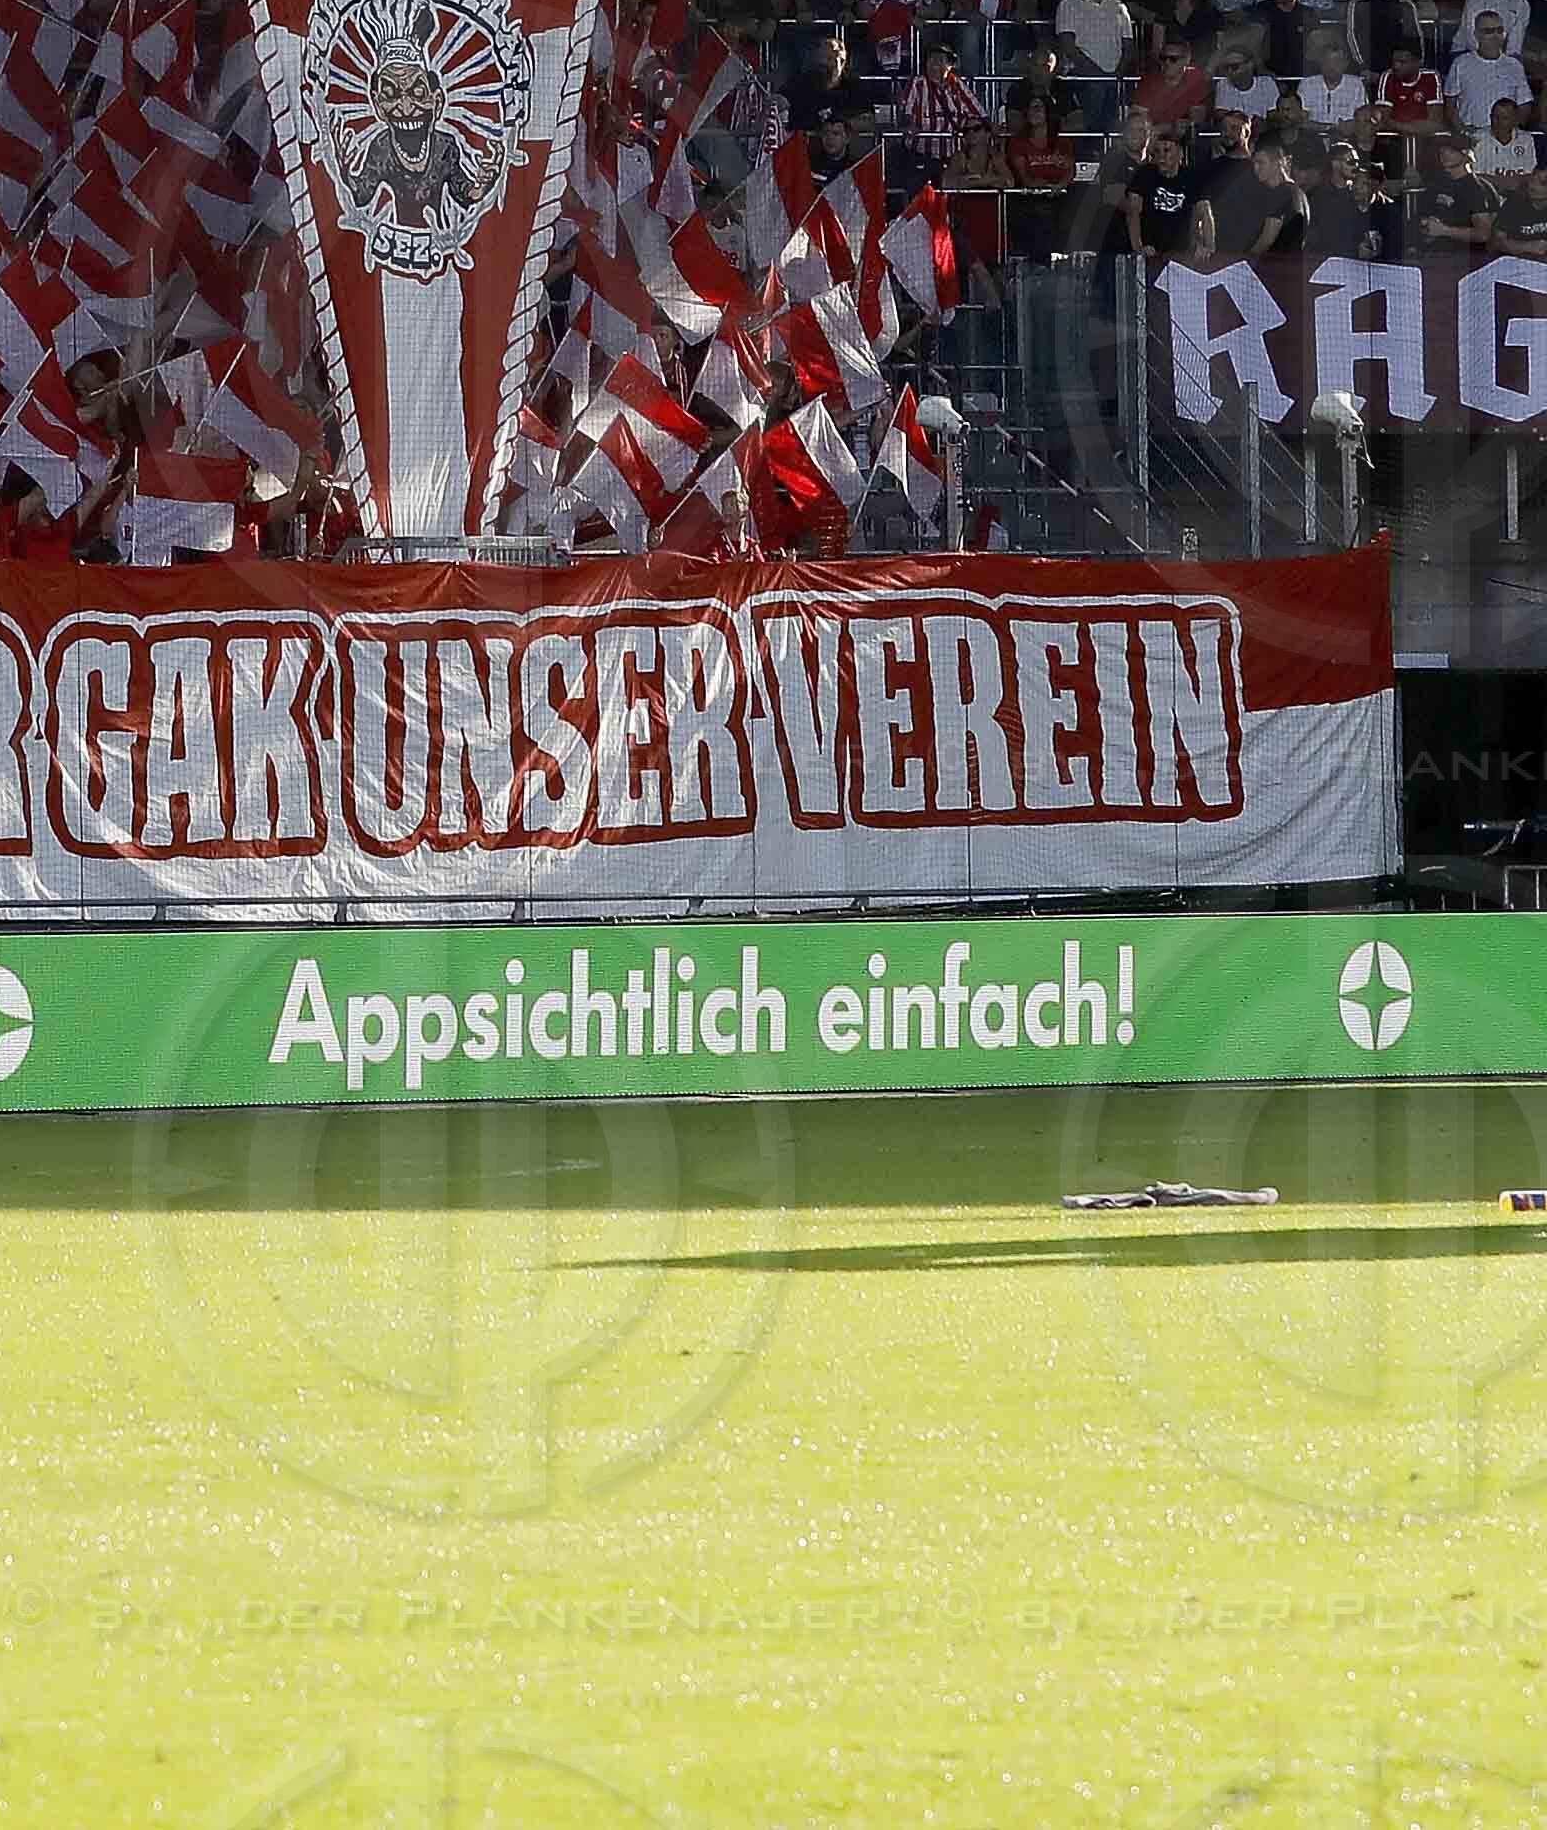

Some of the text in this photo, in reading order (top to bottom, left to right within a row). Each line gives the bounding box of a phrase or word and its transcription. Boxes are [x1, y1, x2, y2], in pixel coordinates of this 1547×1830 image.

[55, 636, 323, 847] GAK
[349, 625, 746, 844] UNSER
[762, 614, 1235, 815] VEREIN
[268, 940, 1136, 1091] Appsichtlich einfach!
